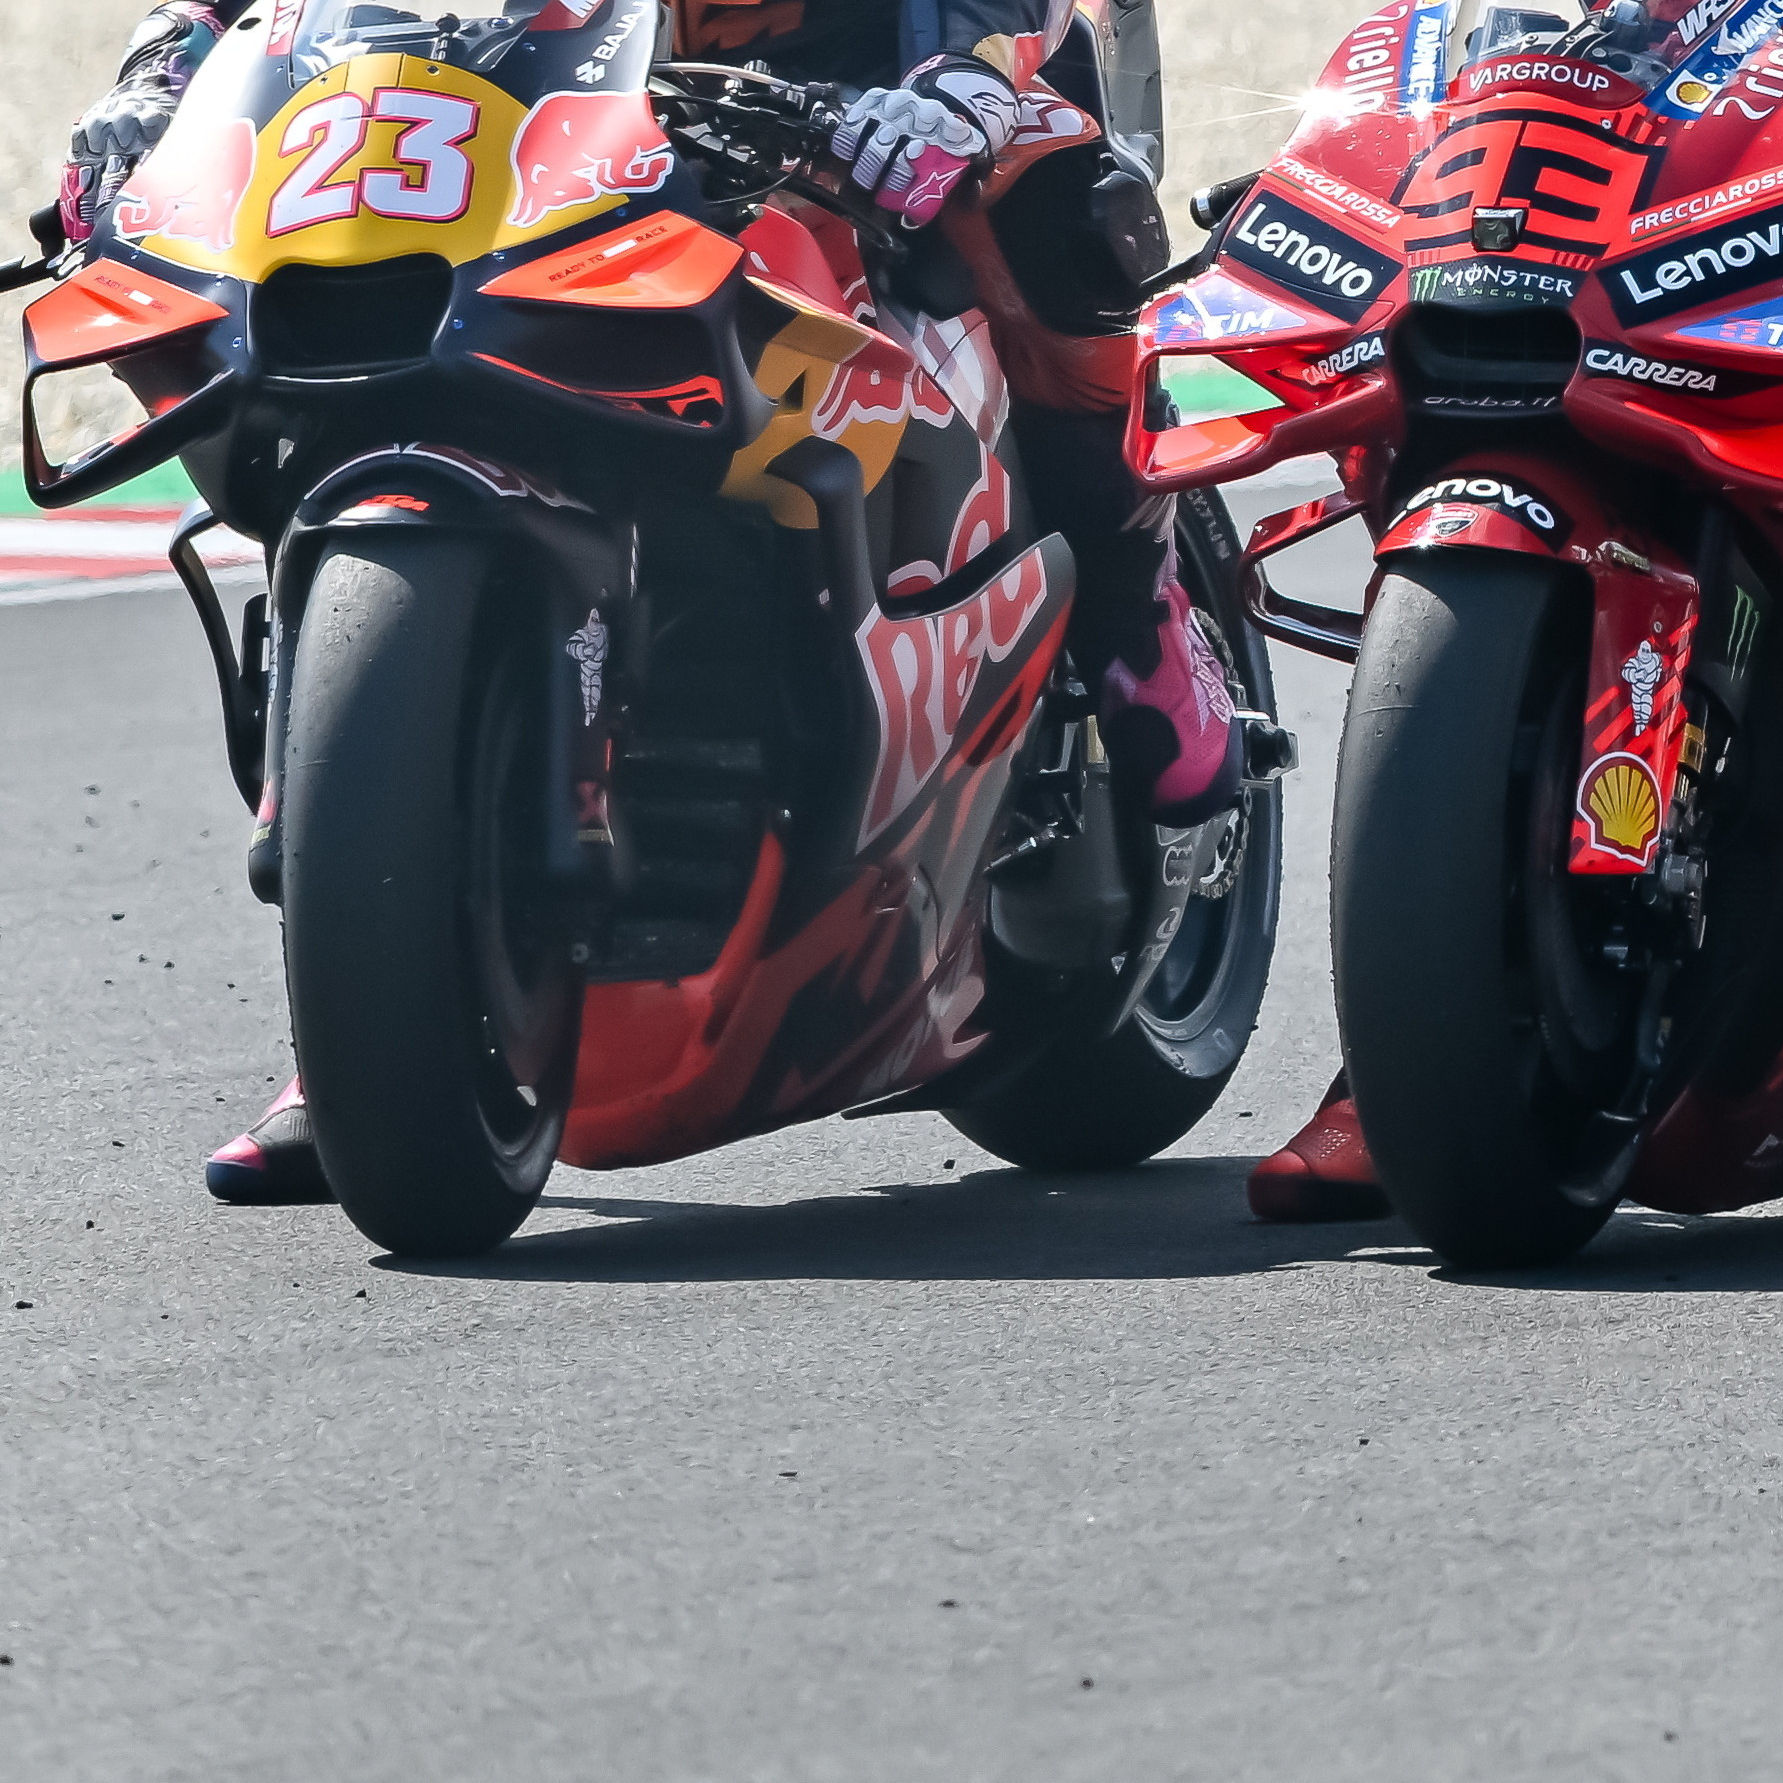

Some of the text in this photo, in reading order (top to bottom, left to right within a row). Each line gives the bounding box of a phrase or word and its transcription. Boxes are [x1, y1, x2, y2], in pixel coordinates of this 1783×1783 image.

[1344, 25, 1401, 113] riello
[1469, 61, 1610, 92] VARGROUP
[268, 86, 478, 239] 23
[1273, 157, 1404, 229] FRECCIAROSSA
[1399, 119, 1649, 245] 93
[548, 225, 668, 282] READY TO RACE
[1234, 202, 1373, 298] Lenovo
[1456, 286, 1550, 305] ENERGY
[1302, 335, 1386, 386] CARRERA
[1585, 348, 1717, 392] CARRERA
